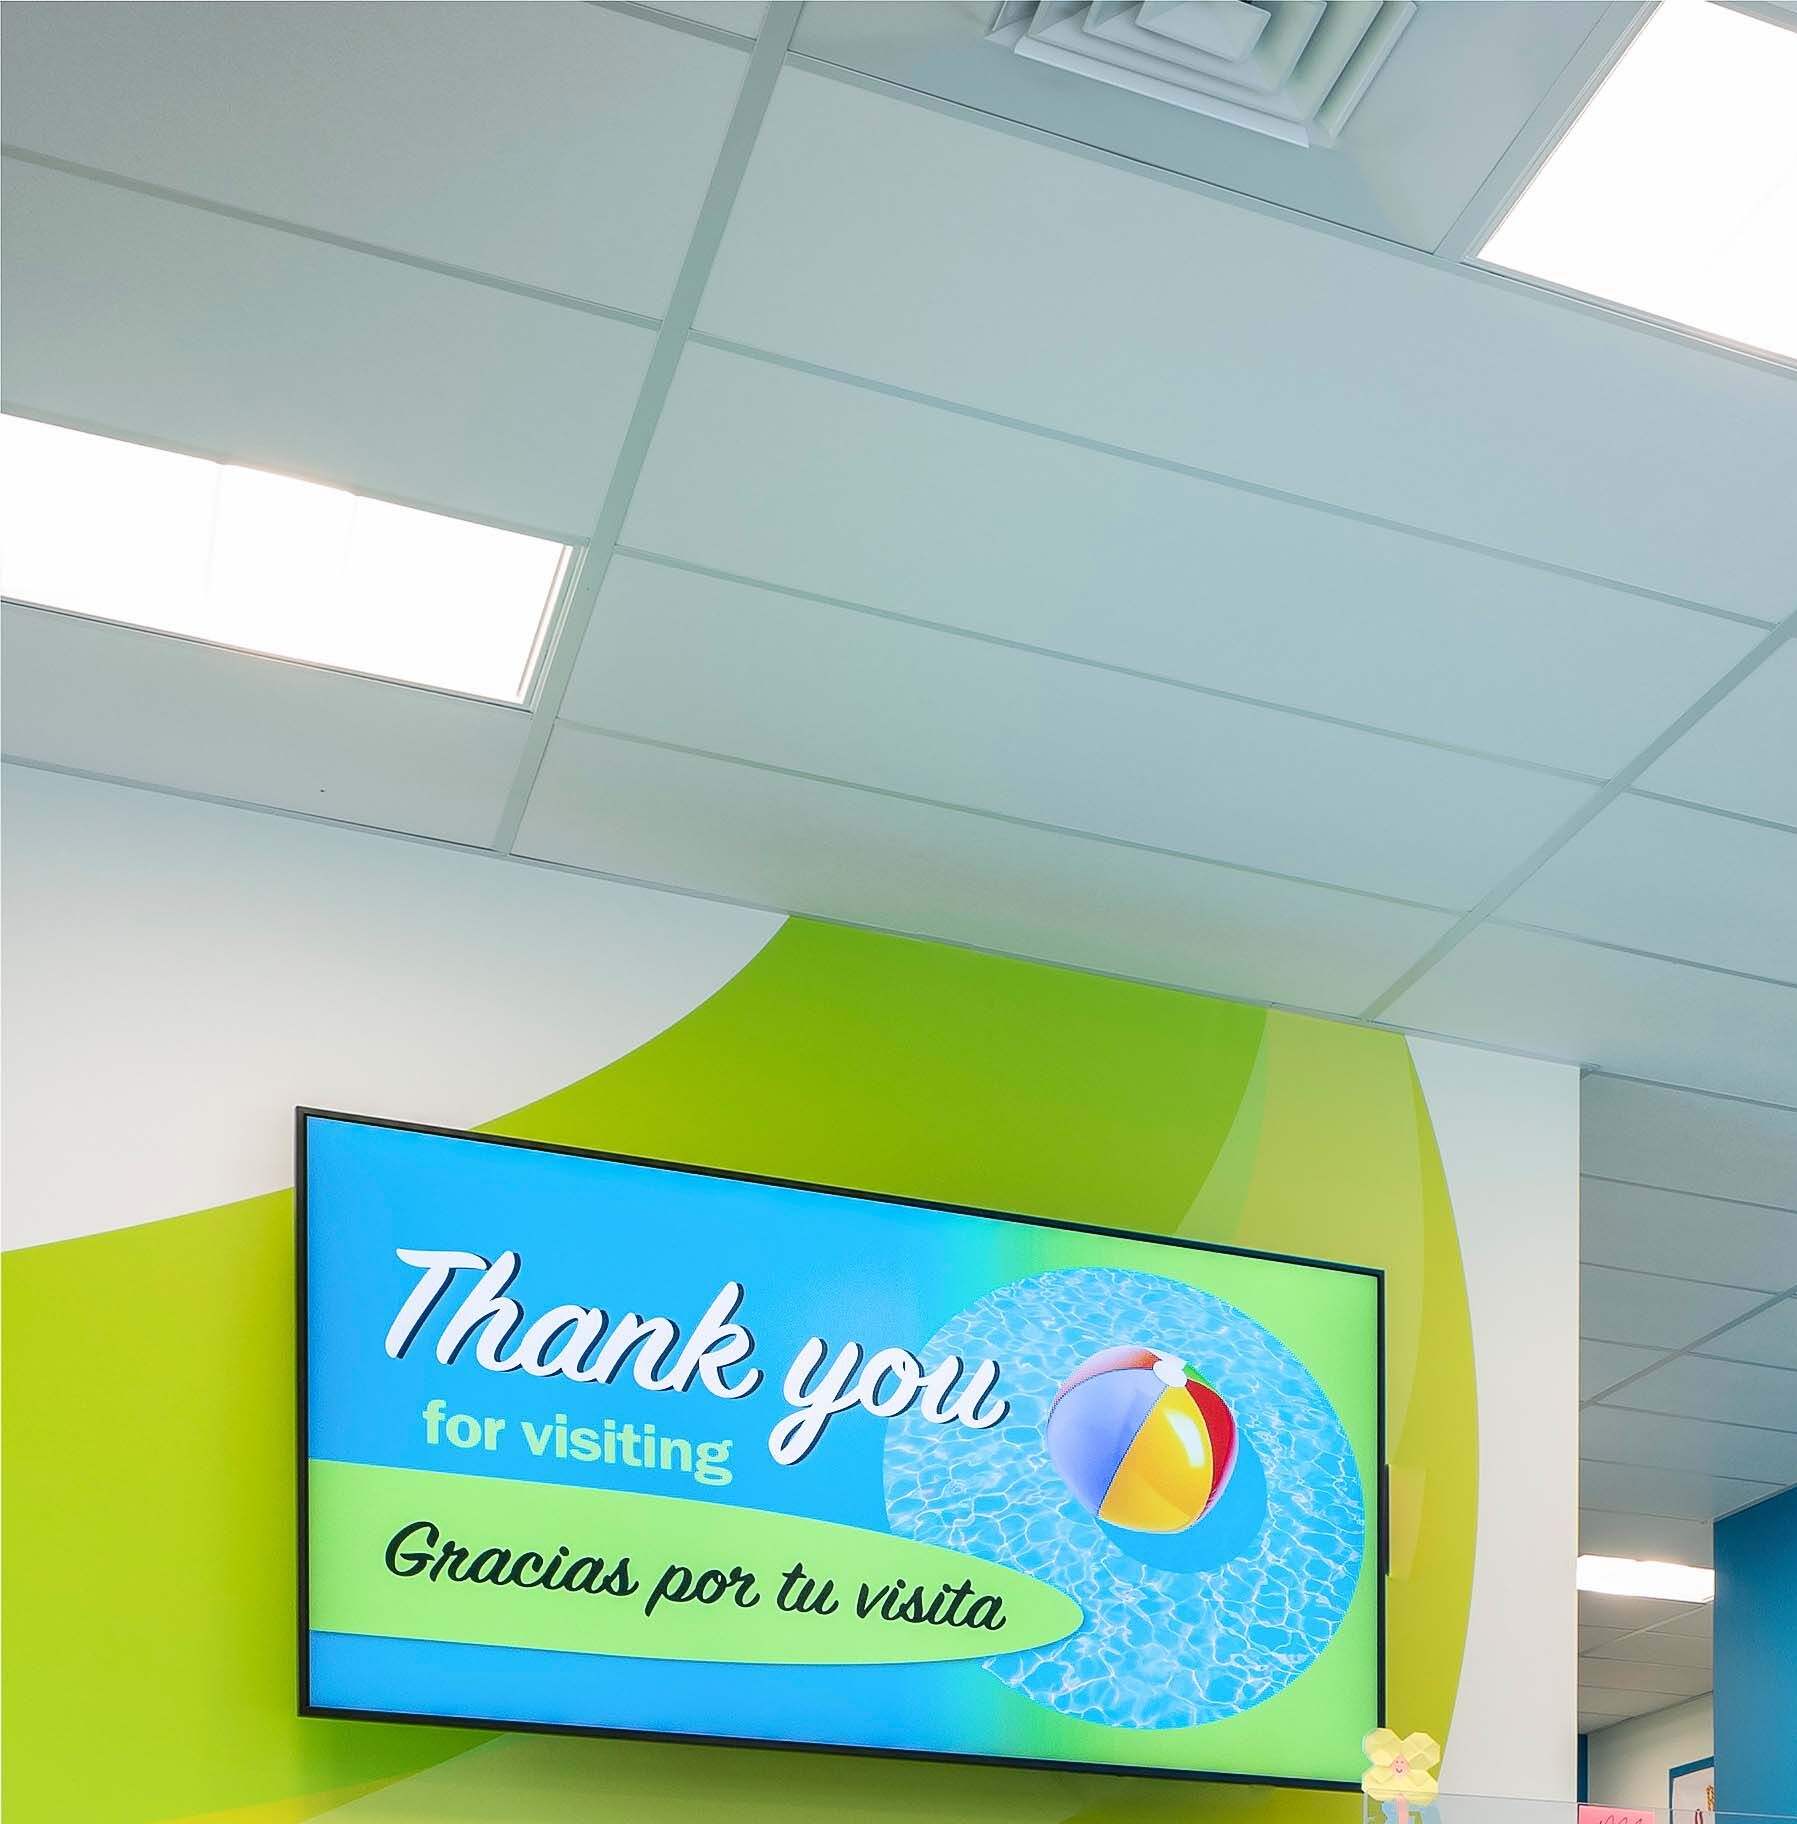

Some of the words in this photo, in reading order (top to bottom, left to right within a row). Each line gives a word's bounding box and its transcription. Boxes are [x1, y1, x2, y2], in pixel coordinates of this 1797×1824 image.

[384, 1246, 764, 1399] Thank
[768, 1335, 1010, 1467] you
[421, 1398, 505, 1453] for
[519, 1408, 734, 1486] visiting
[383, 1520, 640, 1598] Gracias
[643, 1558, 761, 1620] por
[776, 1565, 839, 1617] tu
[851, 1576, 1007, 1634] visita
